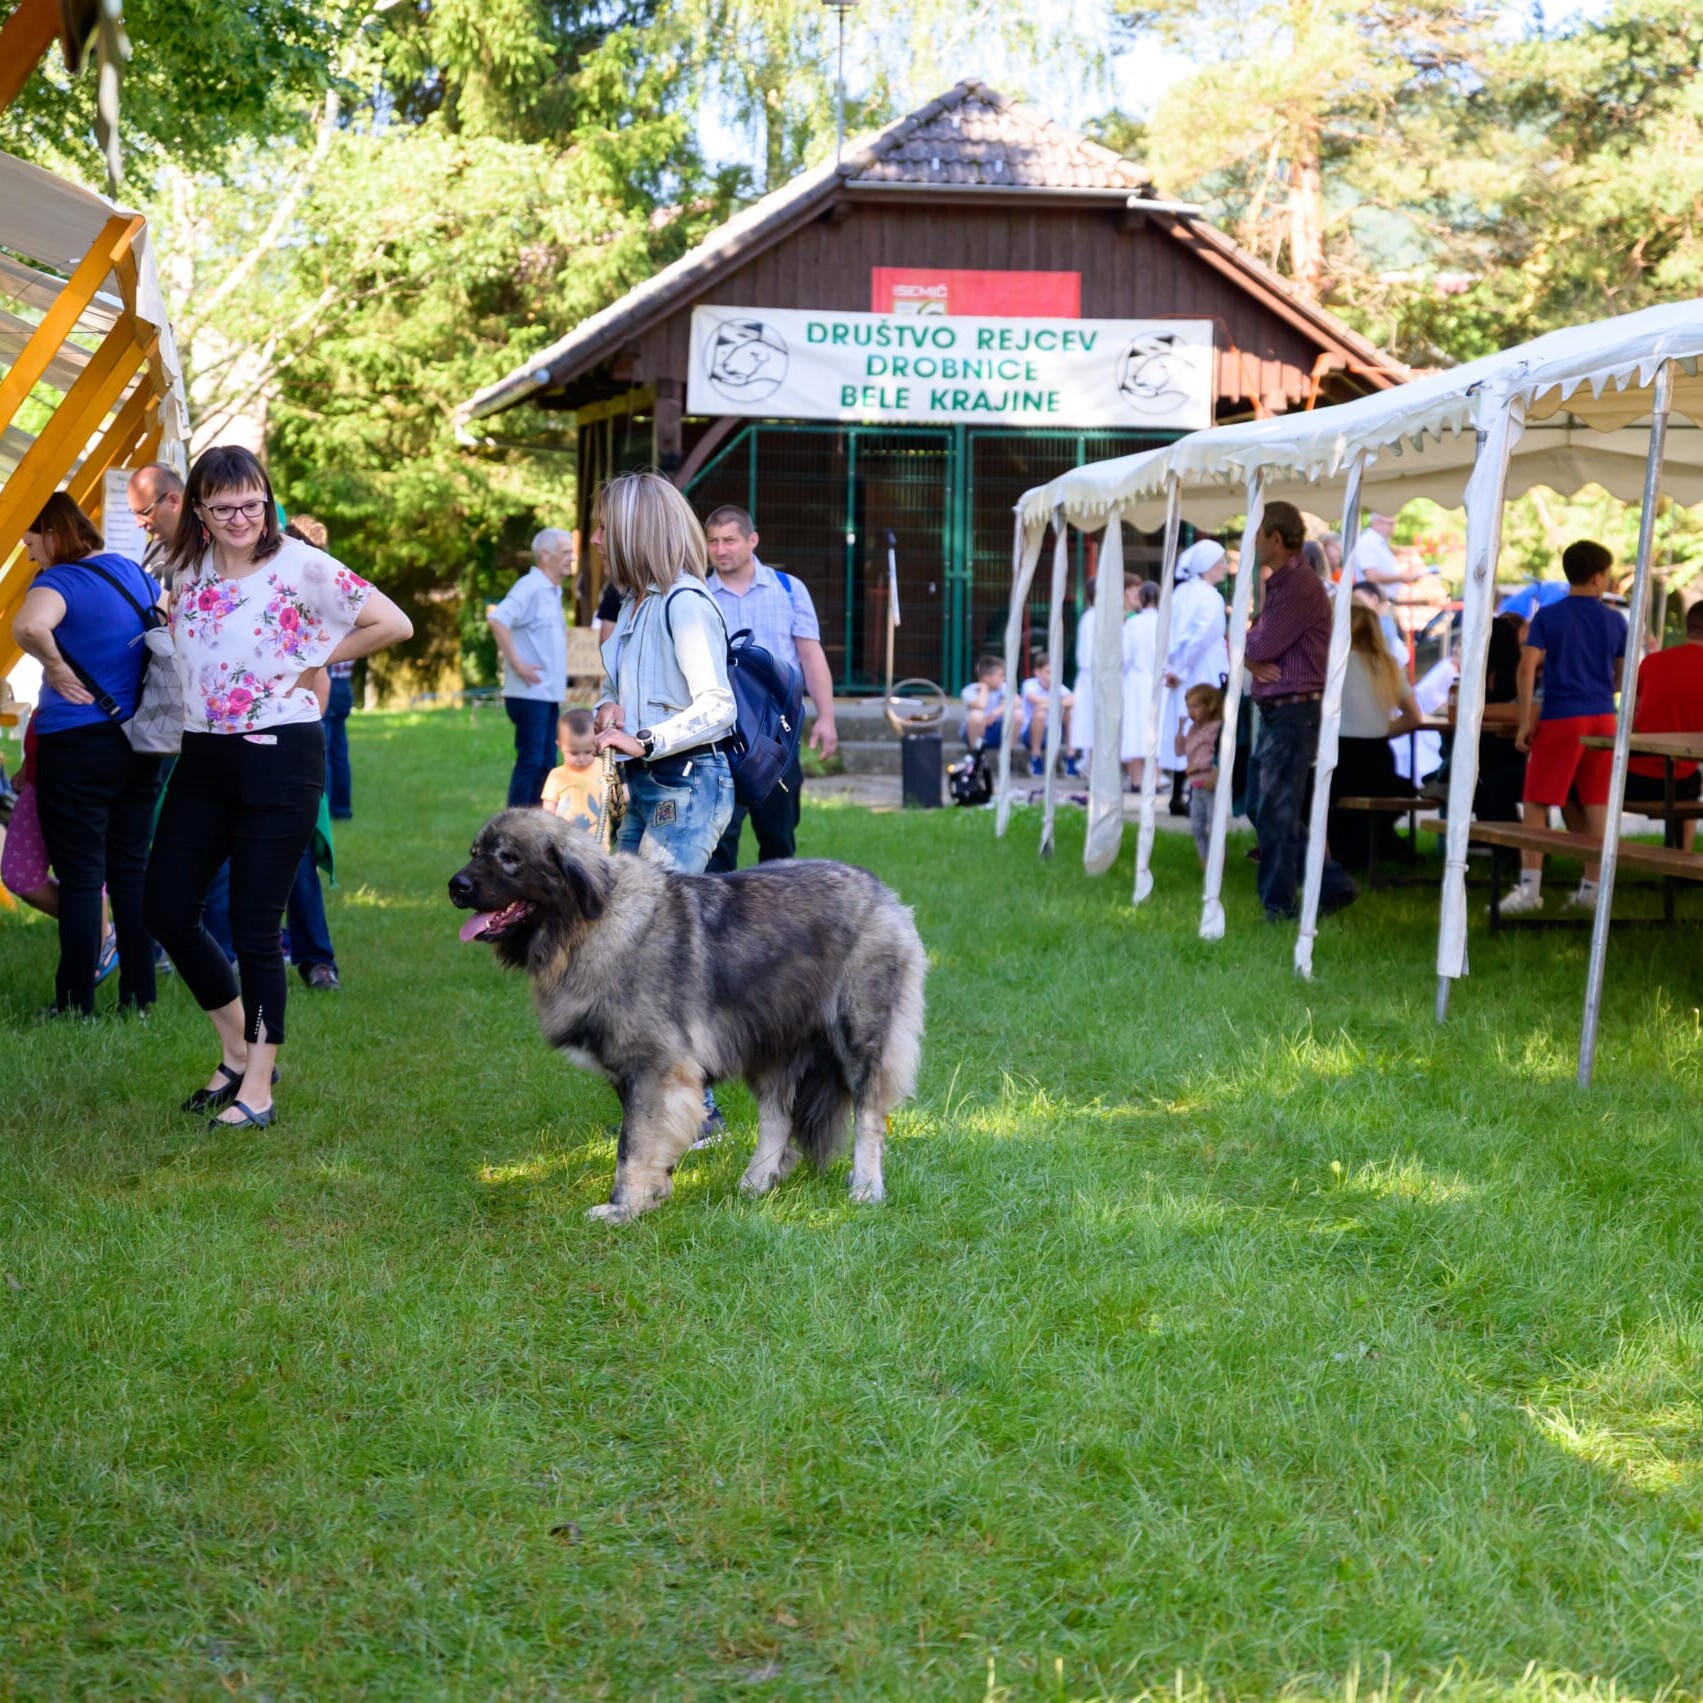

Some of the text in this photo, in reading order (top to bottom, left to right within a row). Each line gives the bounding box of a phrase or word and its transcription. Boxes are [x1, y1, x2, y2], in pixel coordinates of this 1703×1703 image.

[807, 319, 1098, 351] DRUŠTVO REJCEV
[866, 354, 1038, 380] DROBNICE
[841, 384, 1060, 412] BELE KRAJINE
